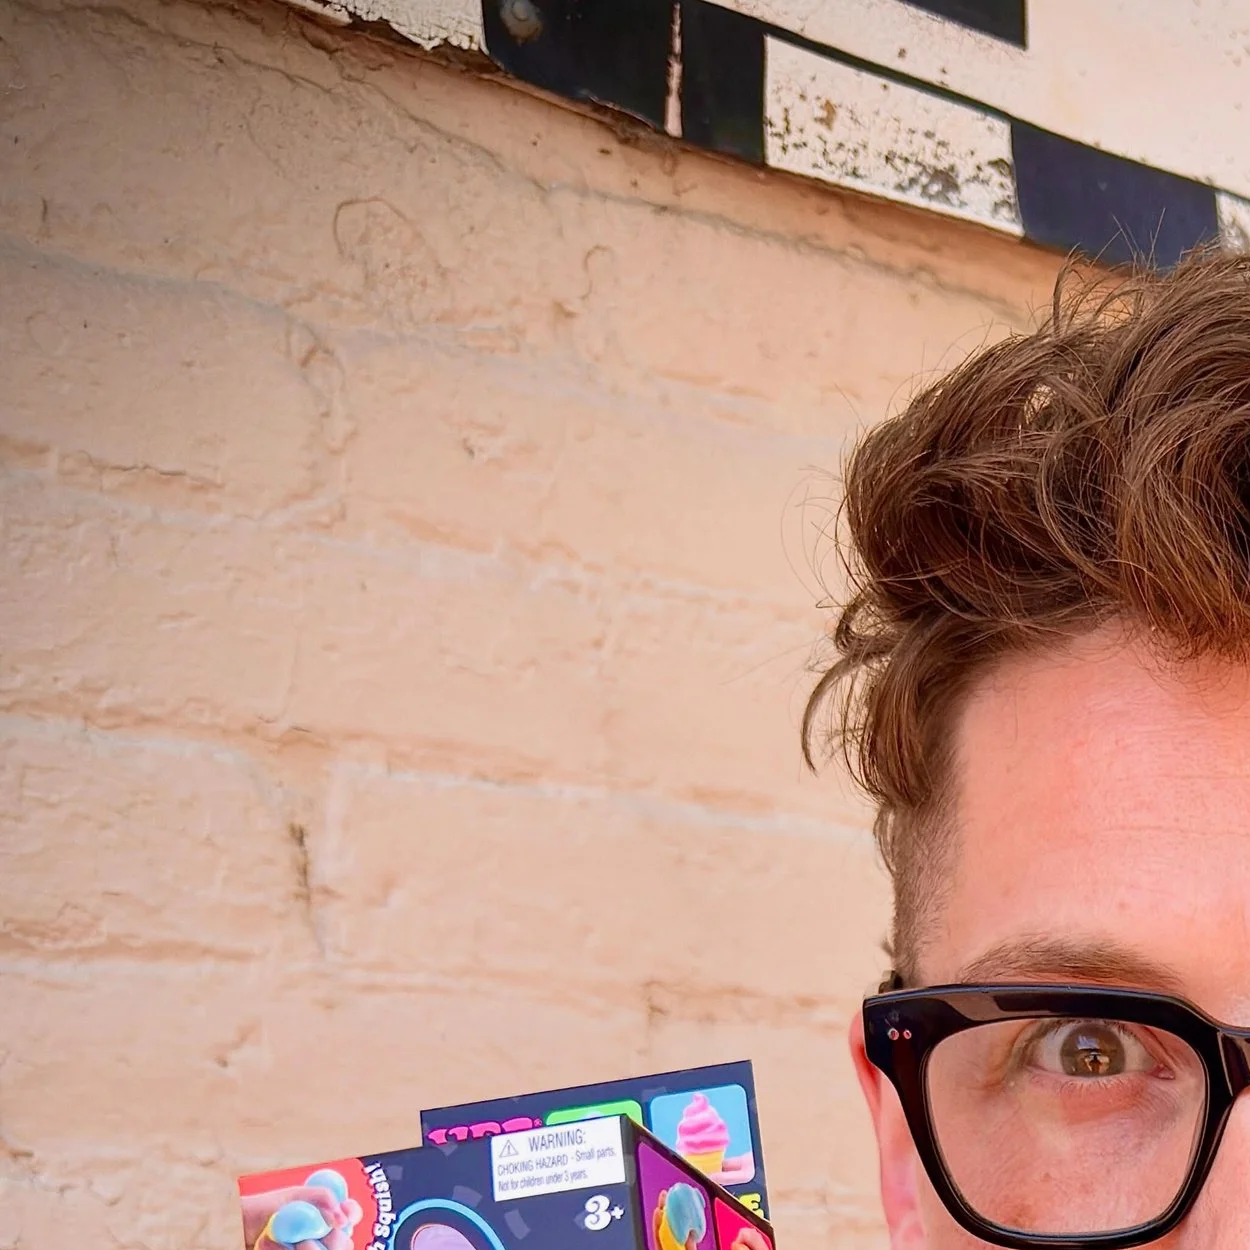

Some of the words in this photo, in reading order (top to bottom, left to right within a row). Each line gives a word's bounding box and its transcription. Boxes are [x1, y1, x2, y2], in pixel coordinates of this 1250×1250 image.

[528, 1128, 587, 1152] WARNING:
[497, 1159, 534, 1176] CHOKING
[535, 1154, 569, 1170] HAZARD
[575, 1148, 595, 1162] Small
[498, 1180, 510, 1192] Not
[510, 1179, 519, 1189] for
[520, 1175, 545, 1189] children
[545, 1171, 565, 1184] under
[364, 1161, 397, 1239] Squish!
[584, 1195, 625, 1231] 3+
